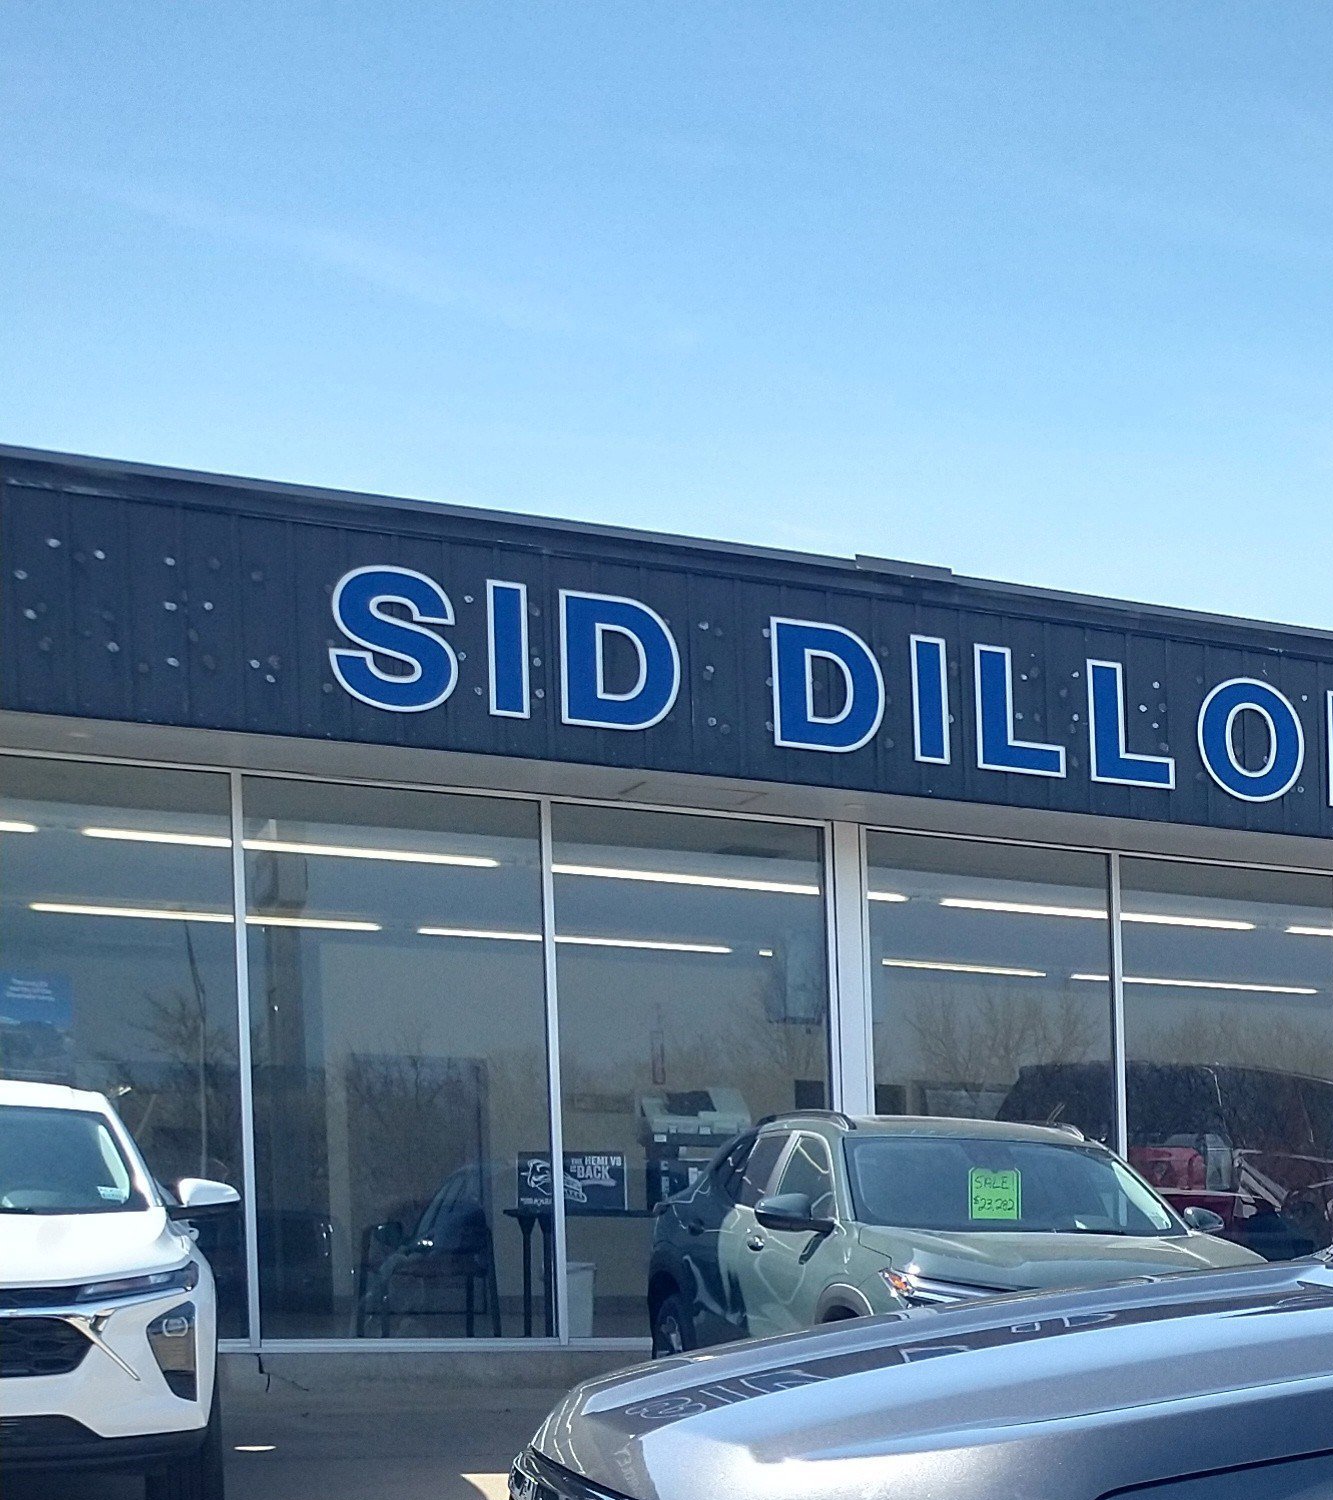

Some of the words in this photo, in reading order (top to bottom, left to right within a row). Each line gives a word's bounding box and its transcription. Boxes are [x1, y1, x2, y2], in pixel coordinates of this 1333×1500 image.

[328, 564, 682, 731] SID
[584, 1156, 608, 1166] HEMI
[610, 1156, 622, 1167] V8
[576, 1165, 610, 1180] BACK
